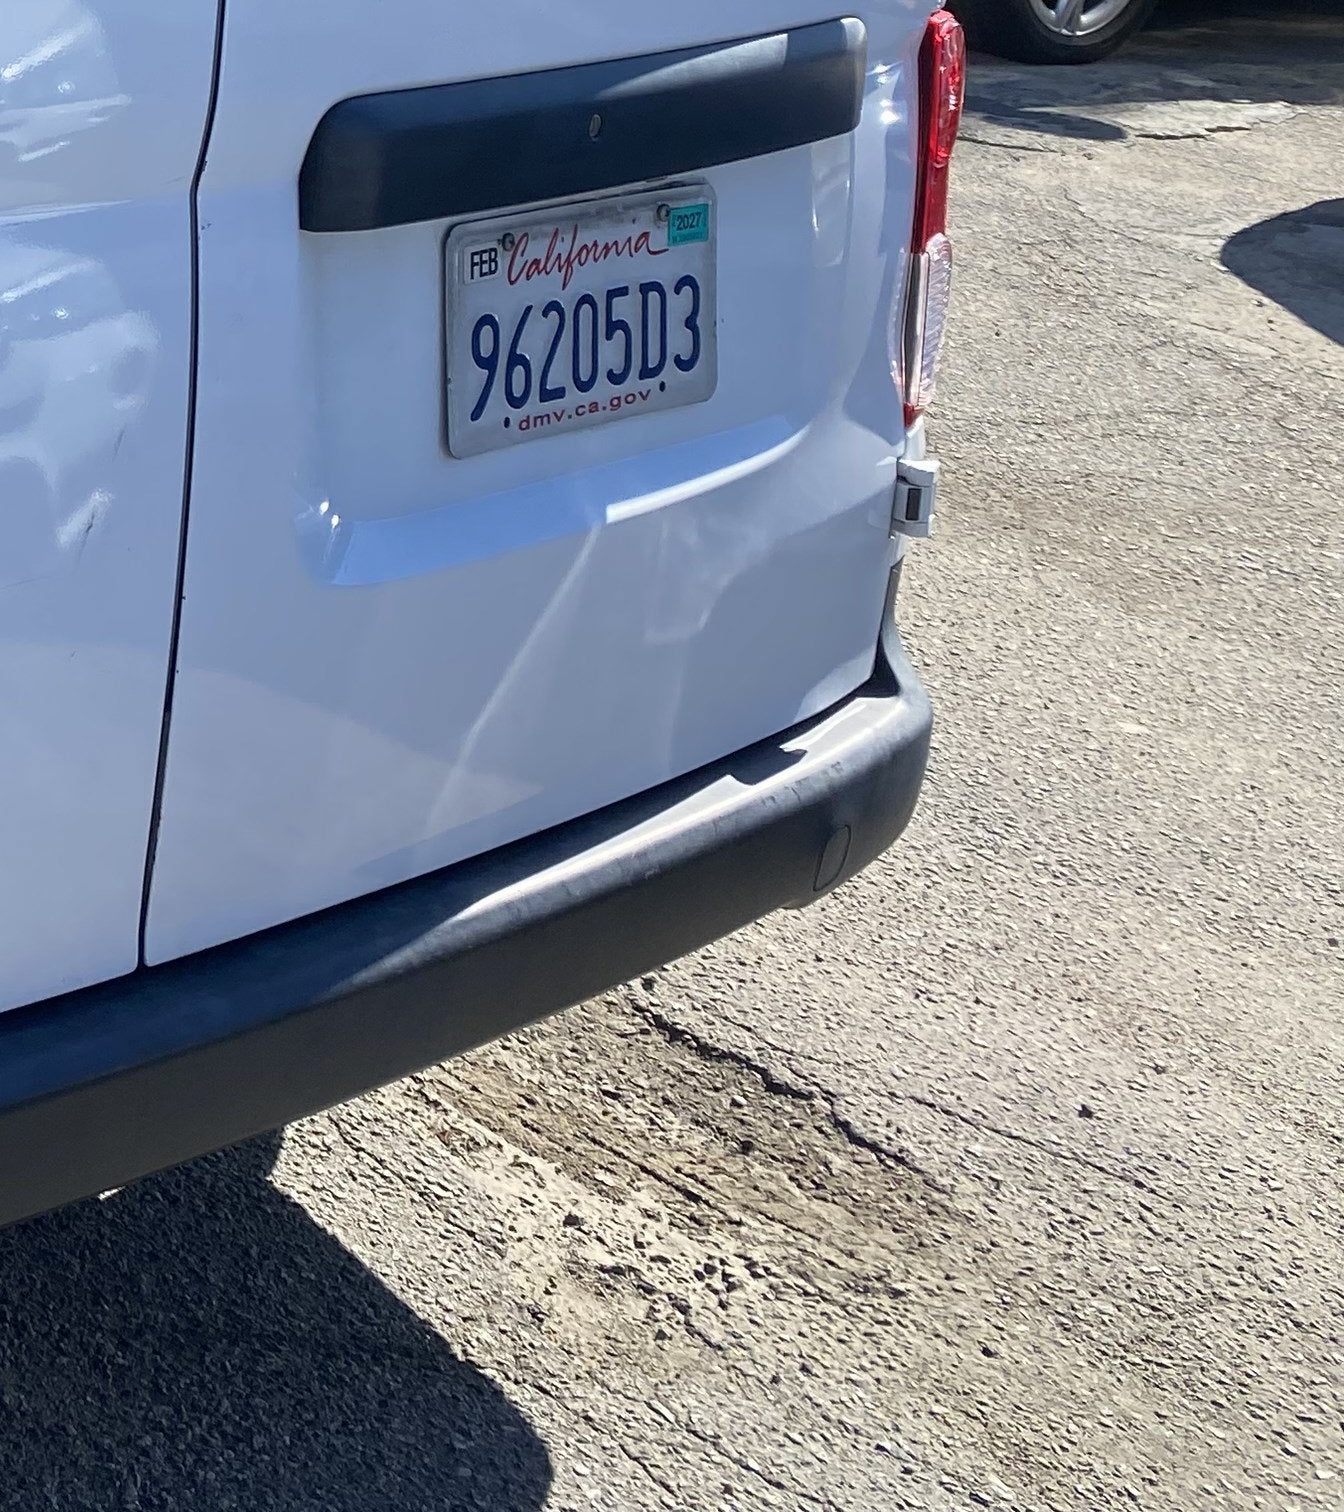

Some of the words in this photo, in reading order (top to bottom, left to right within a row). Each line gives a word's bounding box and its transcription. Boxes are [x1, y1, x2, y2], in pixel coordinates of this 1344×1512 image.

[470, 247, 499, 280] FEB
[507, 223, 670, 291] California
[676, 211, 702, 231] 2027
[469, 274, 701, 422] 96205D3
[518, 389, 652, 431] dmv.ca.gov
